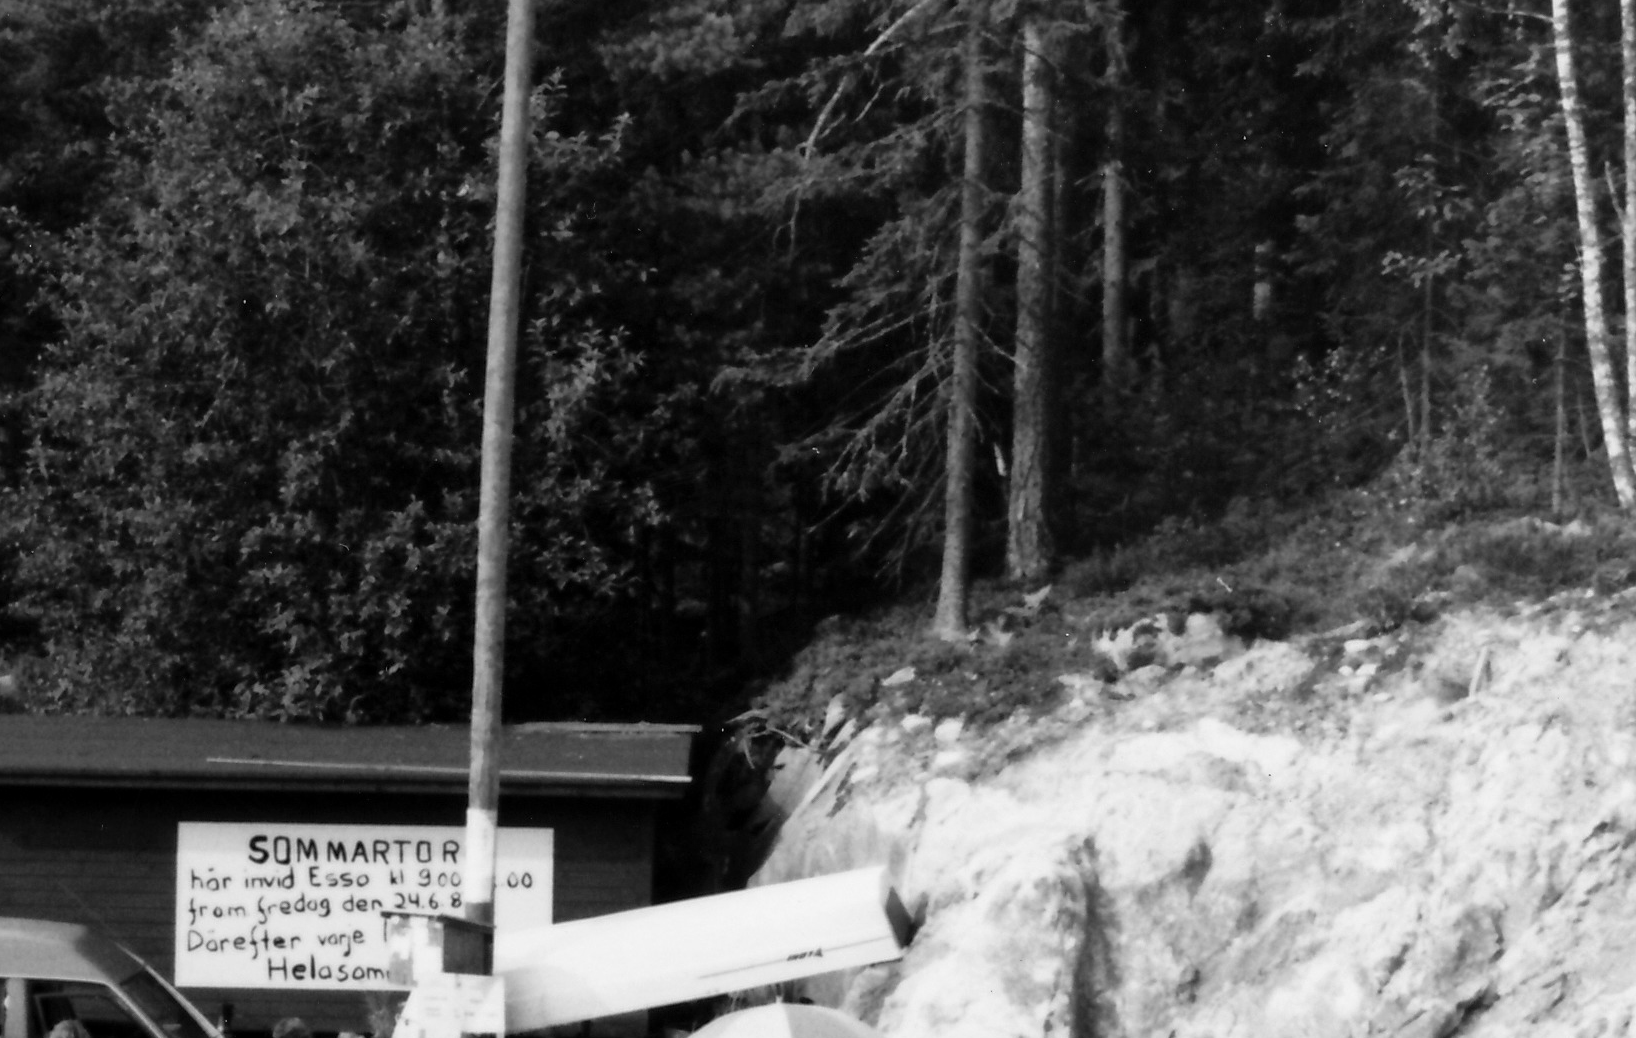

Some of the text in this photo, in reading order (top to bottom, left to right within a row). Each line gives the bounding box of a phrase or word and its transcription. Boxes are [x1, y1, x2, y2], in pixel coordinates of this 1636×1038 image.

[248, 834, 461, 865] SOMMARTOR
[244, 865, 295, 890] invid
[308, 865, 370, 889] Esso
[257, 892, 331, 926] fredag
[341, 893, 383, 913] den
[317, 923, 366, 958] varje
[267, 953, 390, 982] Helasom
